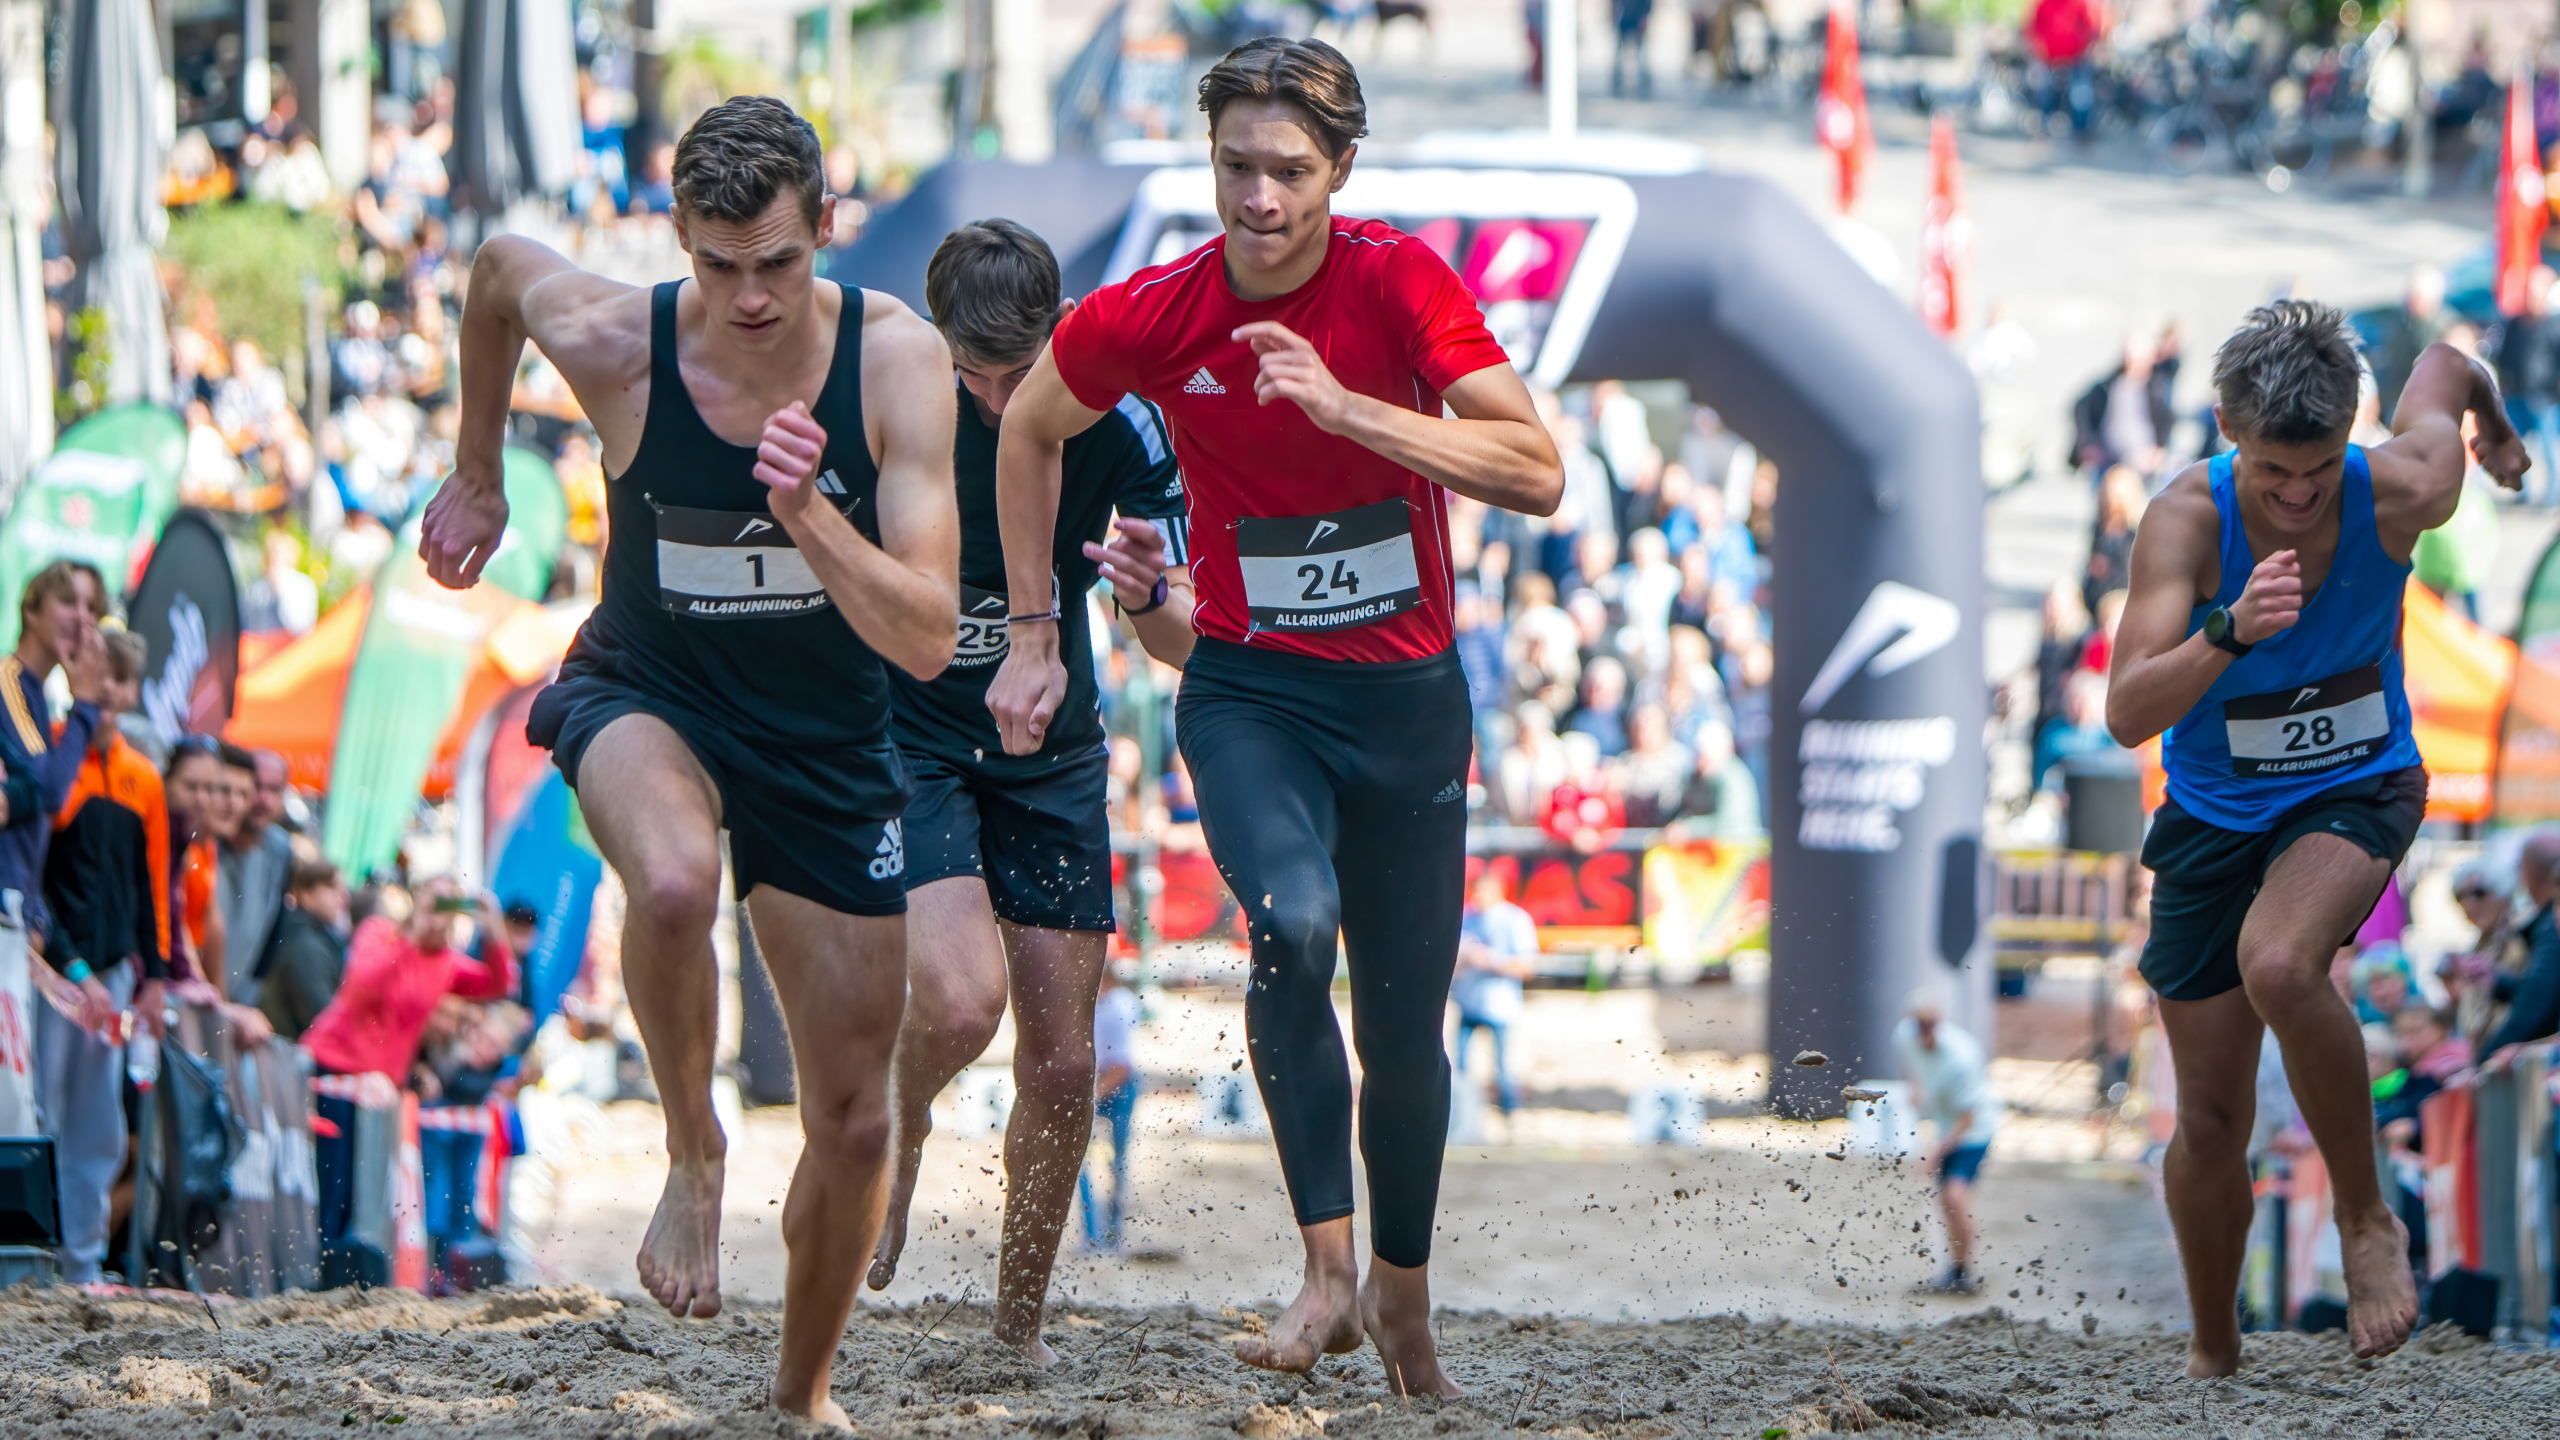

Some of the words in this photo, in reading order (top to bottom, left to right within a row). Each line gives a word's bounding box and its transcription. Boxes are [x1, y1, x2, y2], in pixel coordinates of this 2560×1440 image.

[1183, 382, 1226, 394] adidas
[746, 553, 765, 588] 1
[1297, 559, 1360, 601] 24
[688, 593, 827, 614] ALL4RUNNING.NL
[1274, 598, 1397, 626] ALL4RUNNING.NL
[957, 622, 1008, 649] 25
[2282, 715, 2336, 752] 28
[2256, 744, 2370, 772] ALL4RUNNING.NL
[1432, 790, 1463, 803] adidas
